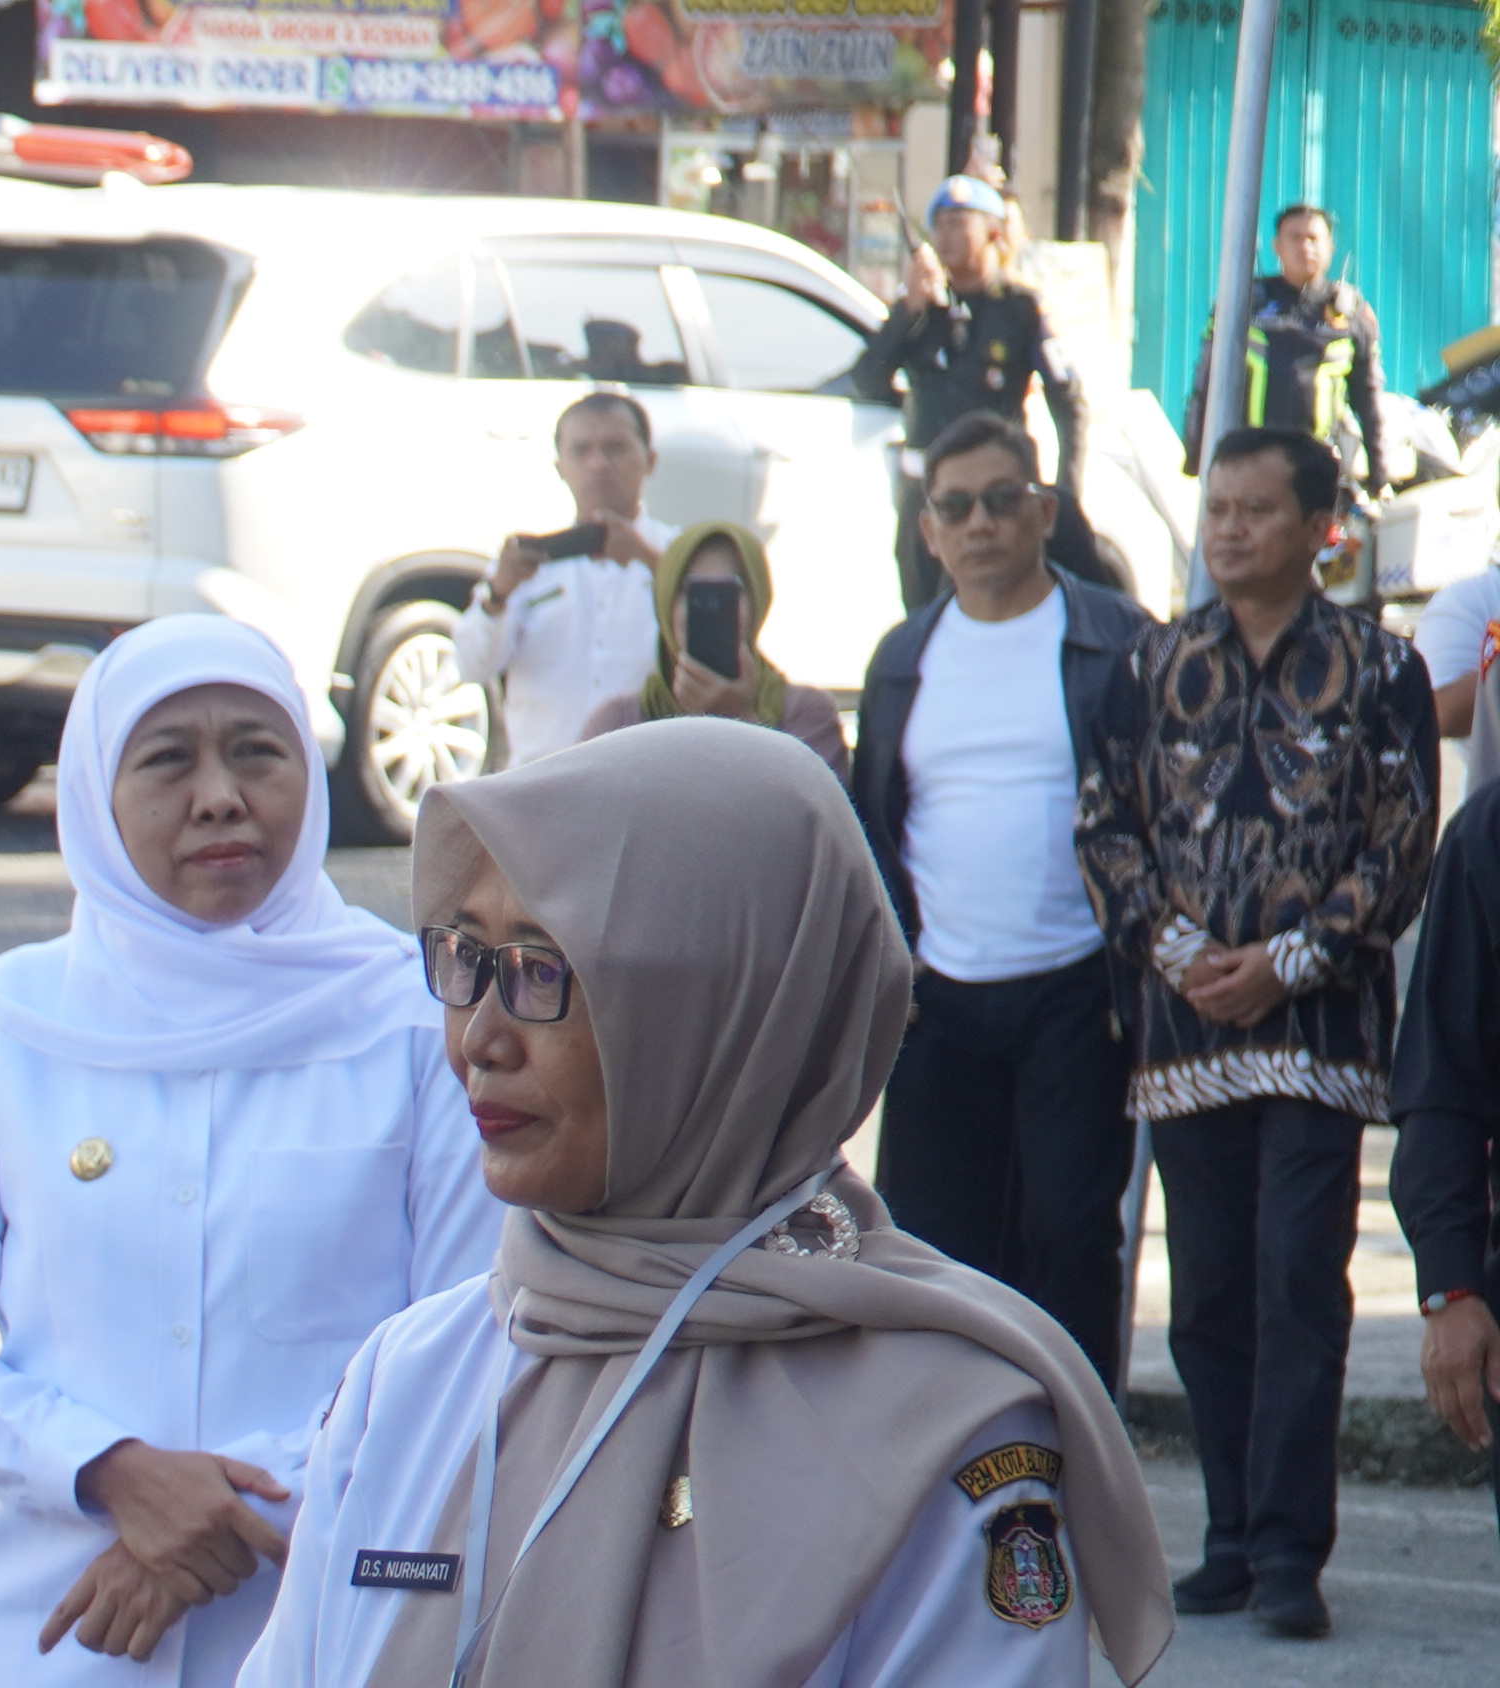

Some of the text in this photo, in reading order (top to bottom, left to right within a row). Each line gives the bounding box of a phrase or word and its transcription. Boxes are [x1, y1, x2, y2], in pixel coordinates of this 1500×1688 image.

[62, 51, 200, 89] DELIVERY
[212, 56, 309, 93] ORDER
[963, 1459, 997, 1494] PEM
[991, 1448, 1028, 1481] KOTA
[360, 1559, 450, 1581] D.S. NURHAYATI
